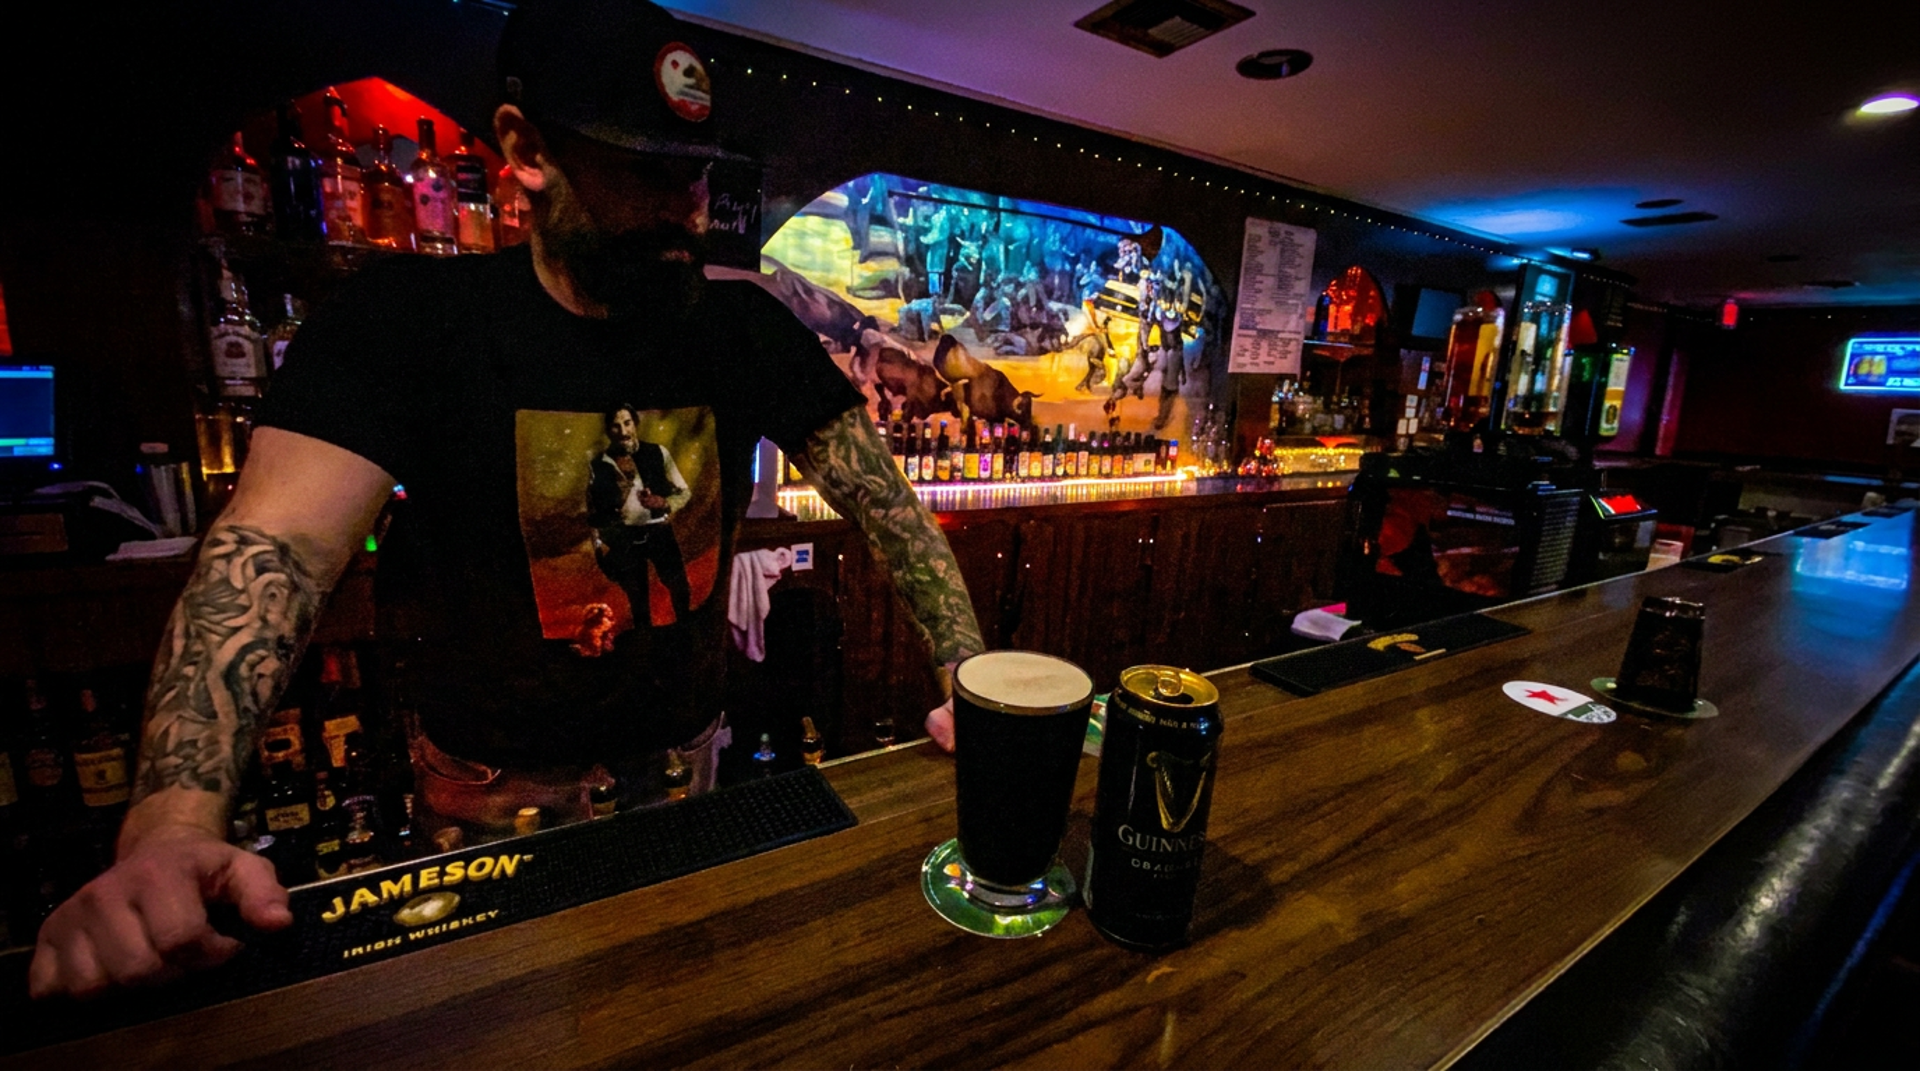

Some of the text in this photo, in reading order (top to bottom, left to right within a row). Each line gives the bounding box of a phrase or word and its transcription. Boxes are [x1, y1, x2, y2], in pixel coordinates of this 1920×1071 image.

[1117, 823, 1206, 853] GUINNES
[320, 853, 521, 924] JAMESON
[407, 908, 500, 942] WHISKEY
